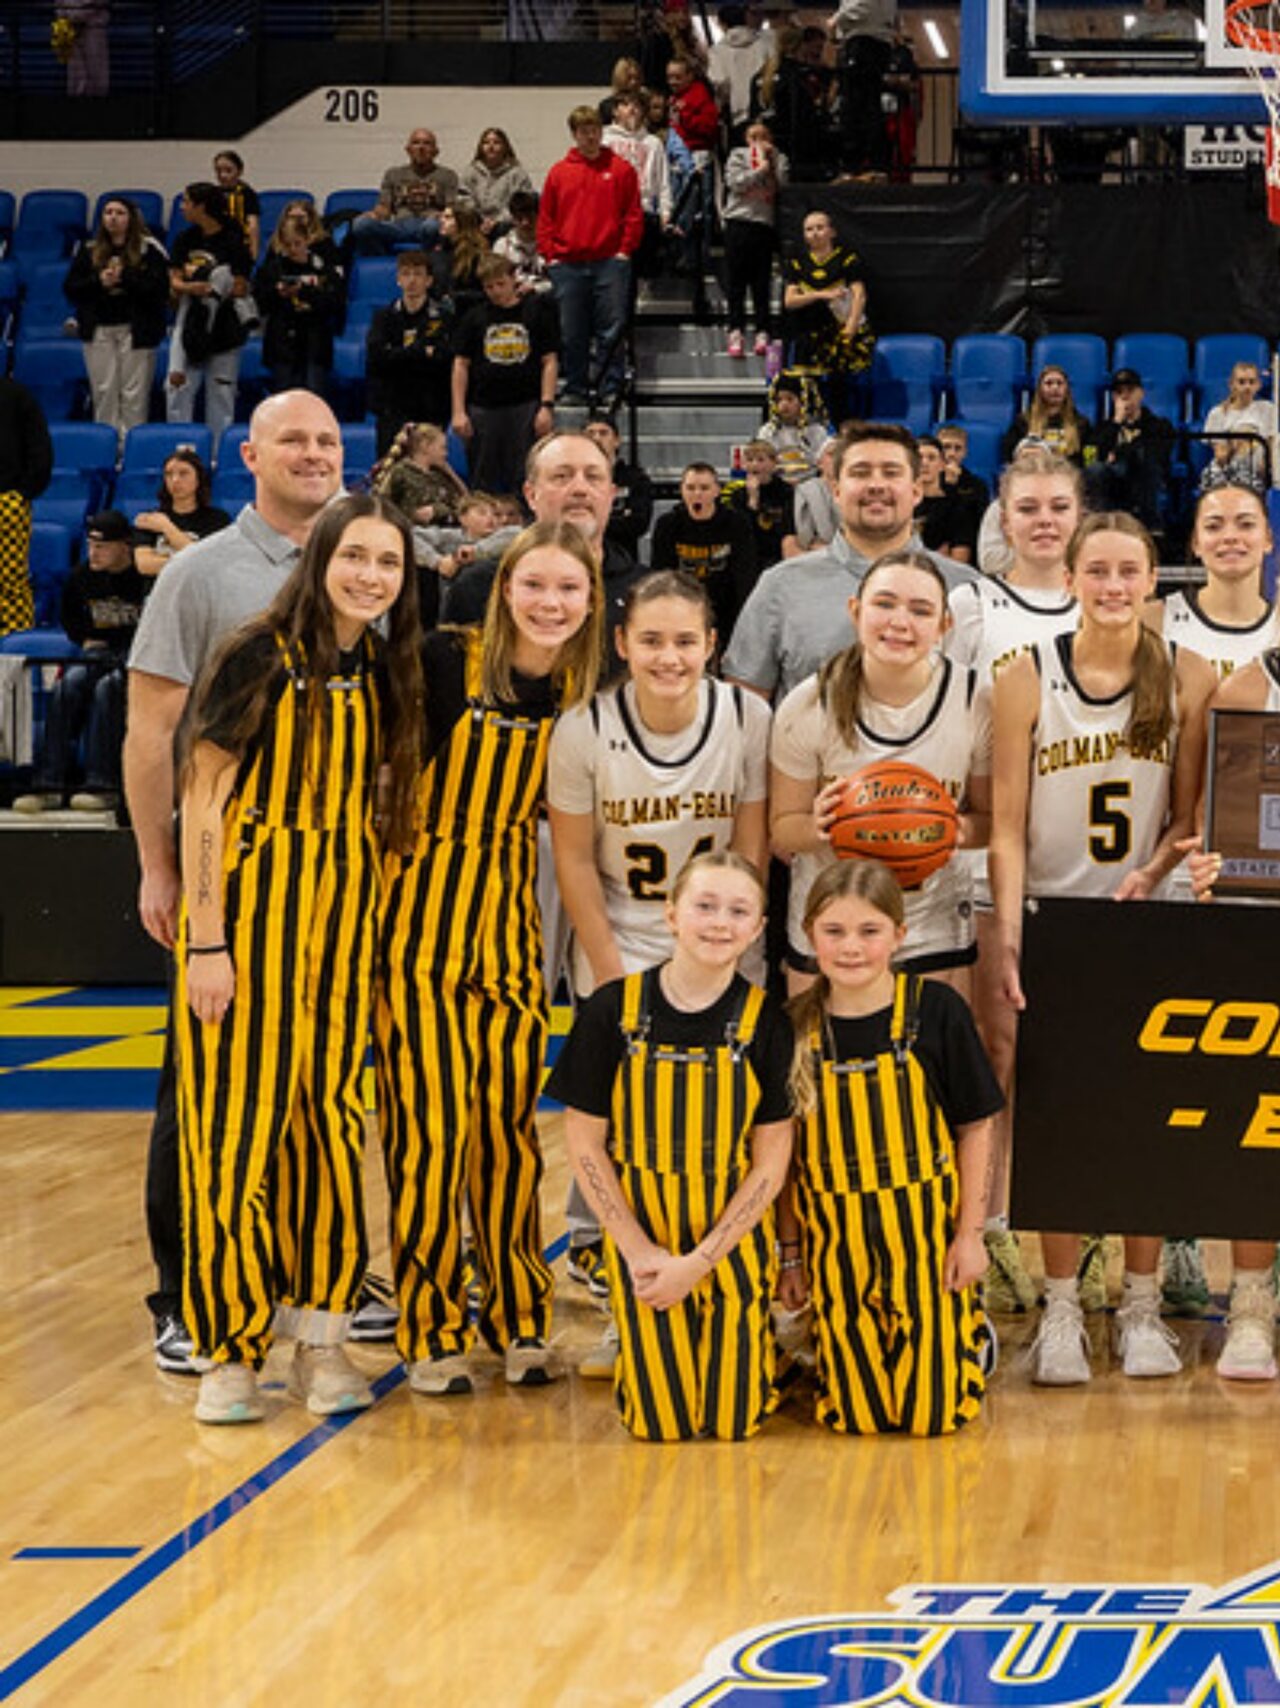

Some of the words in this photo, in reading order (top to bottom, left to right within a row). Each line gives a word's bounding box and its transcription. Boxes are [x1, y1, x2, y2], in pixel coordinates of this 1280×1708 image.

[325, 89, 379, 122] 206
[1088, 778, 1132, 863] 5
[624, 834, 715, 902] 2
[1227, 861, 1279, 875] STATE
[910, 1588, 1193, 1616] THE
